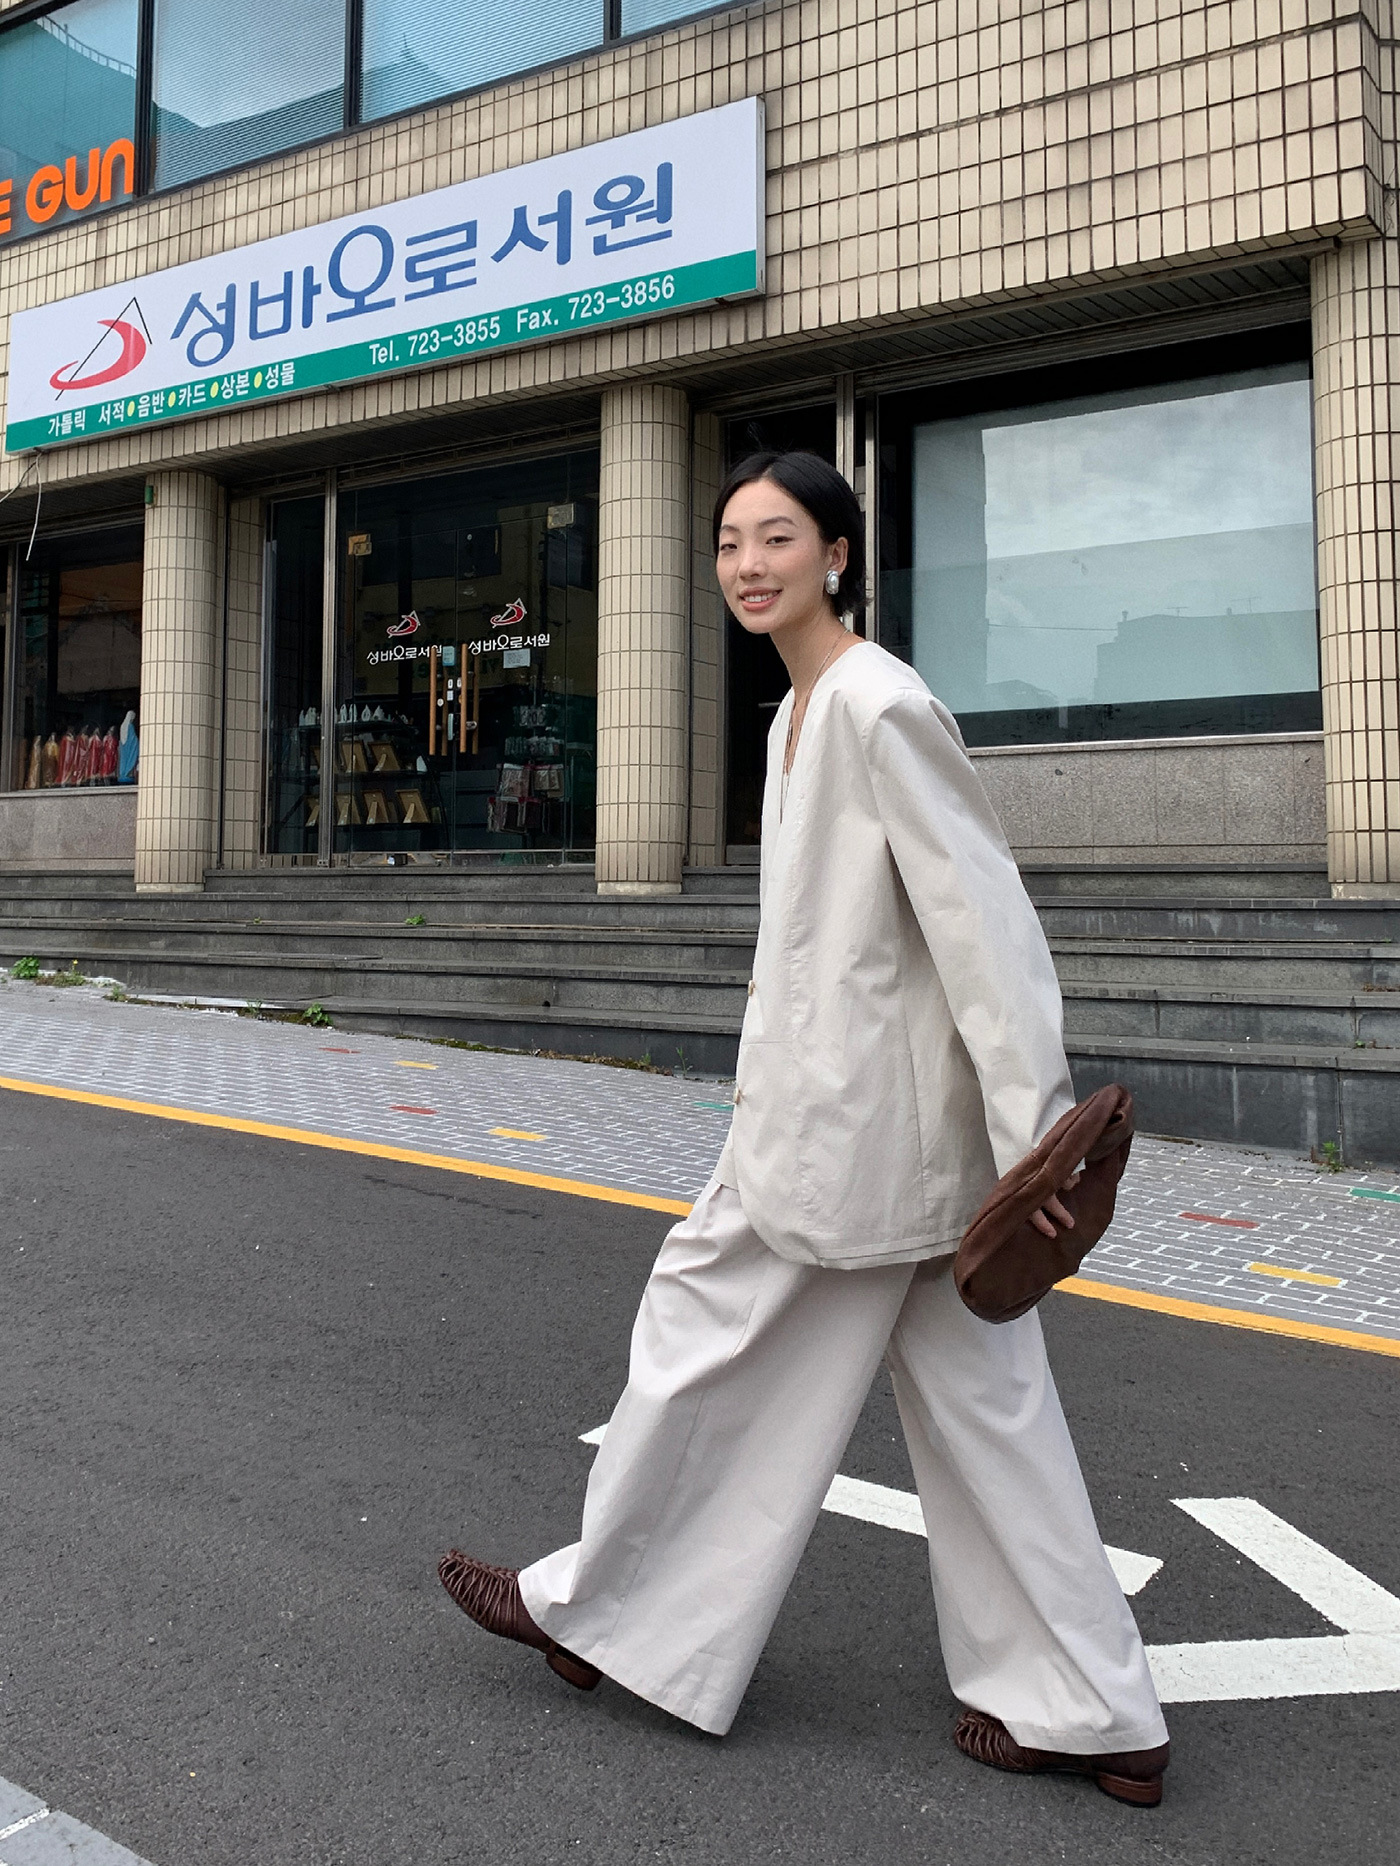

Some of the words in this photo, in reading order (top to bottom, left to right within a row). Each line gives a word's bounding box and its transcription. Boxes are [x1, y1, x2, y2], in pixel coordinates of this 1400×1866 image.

[25, 138, 135, 224] GUN
[170, 161, 673, 368] 성바오로서원
[369, 341, 400, 366] Tel.
[407, 316, 501, 358] 723-3855
[516, 306, 560, 334] Fax.
[568, 274, 676, 321] 723-3856
[48, 410, 86, 436] 가톨릭
[98, 399, 125, 426] 서적
[137, 391, 166, 418] 음반
[178, 383, 206, 409] 카드
[220, 371, 250, 399] 상본
[264, 361, 296, 390] 성물
[468, 633, 551, 655] 성바오로서원
